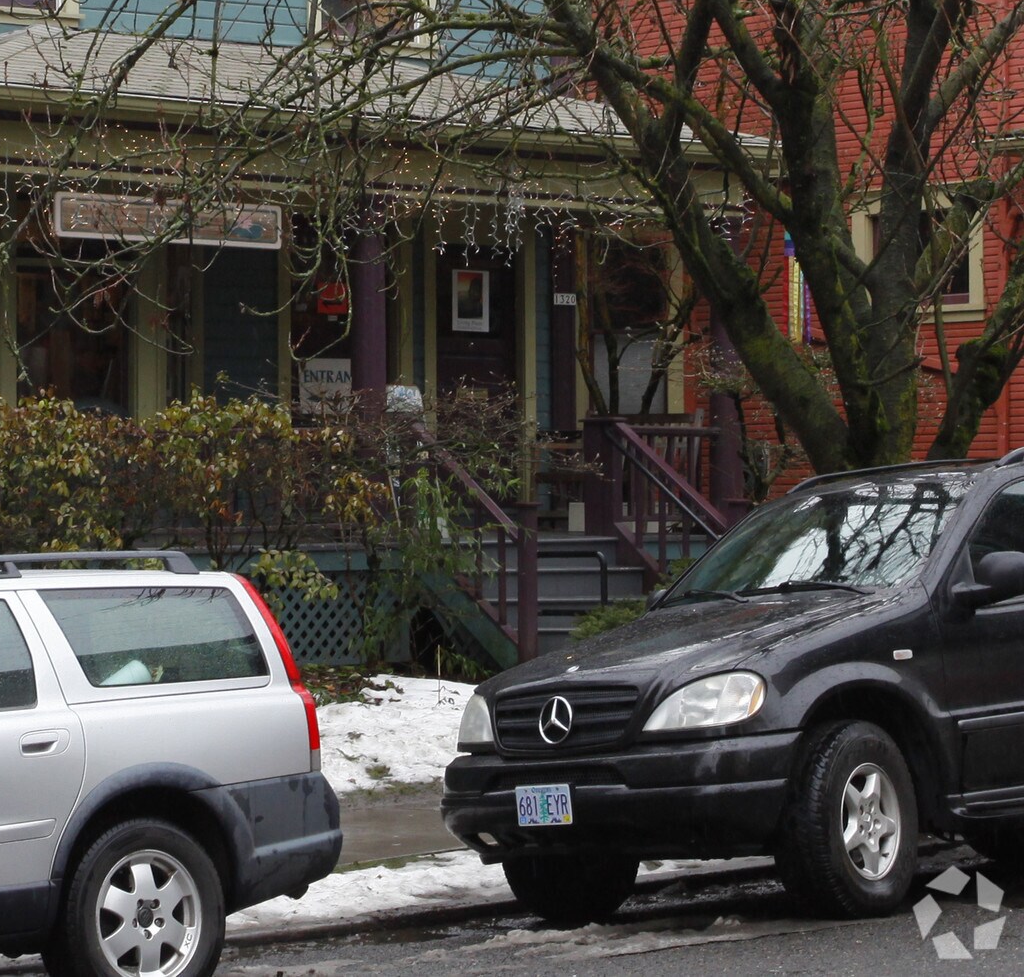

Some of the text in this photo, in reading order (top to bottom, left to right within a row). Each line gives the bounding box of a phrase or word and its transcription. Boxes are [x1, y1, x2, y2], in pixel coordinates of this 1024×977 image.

[555, 294, 576, 304] 1320
[519, 794, 569, 817] 681 EYR
[184, 933, 193, 948] XC
